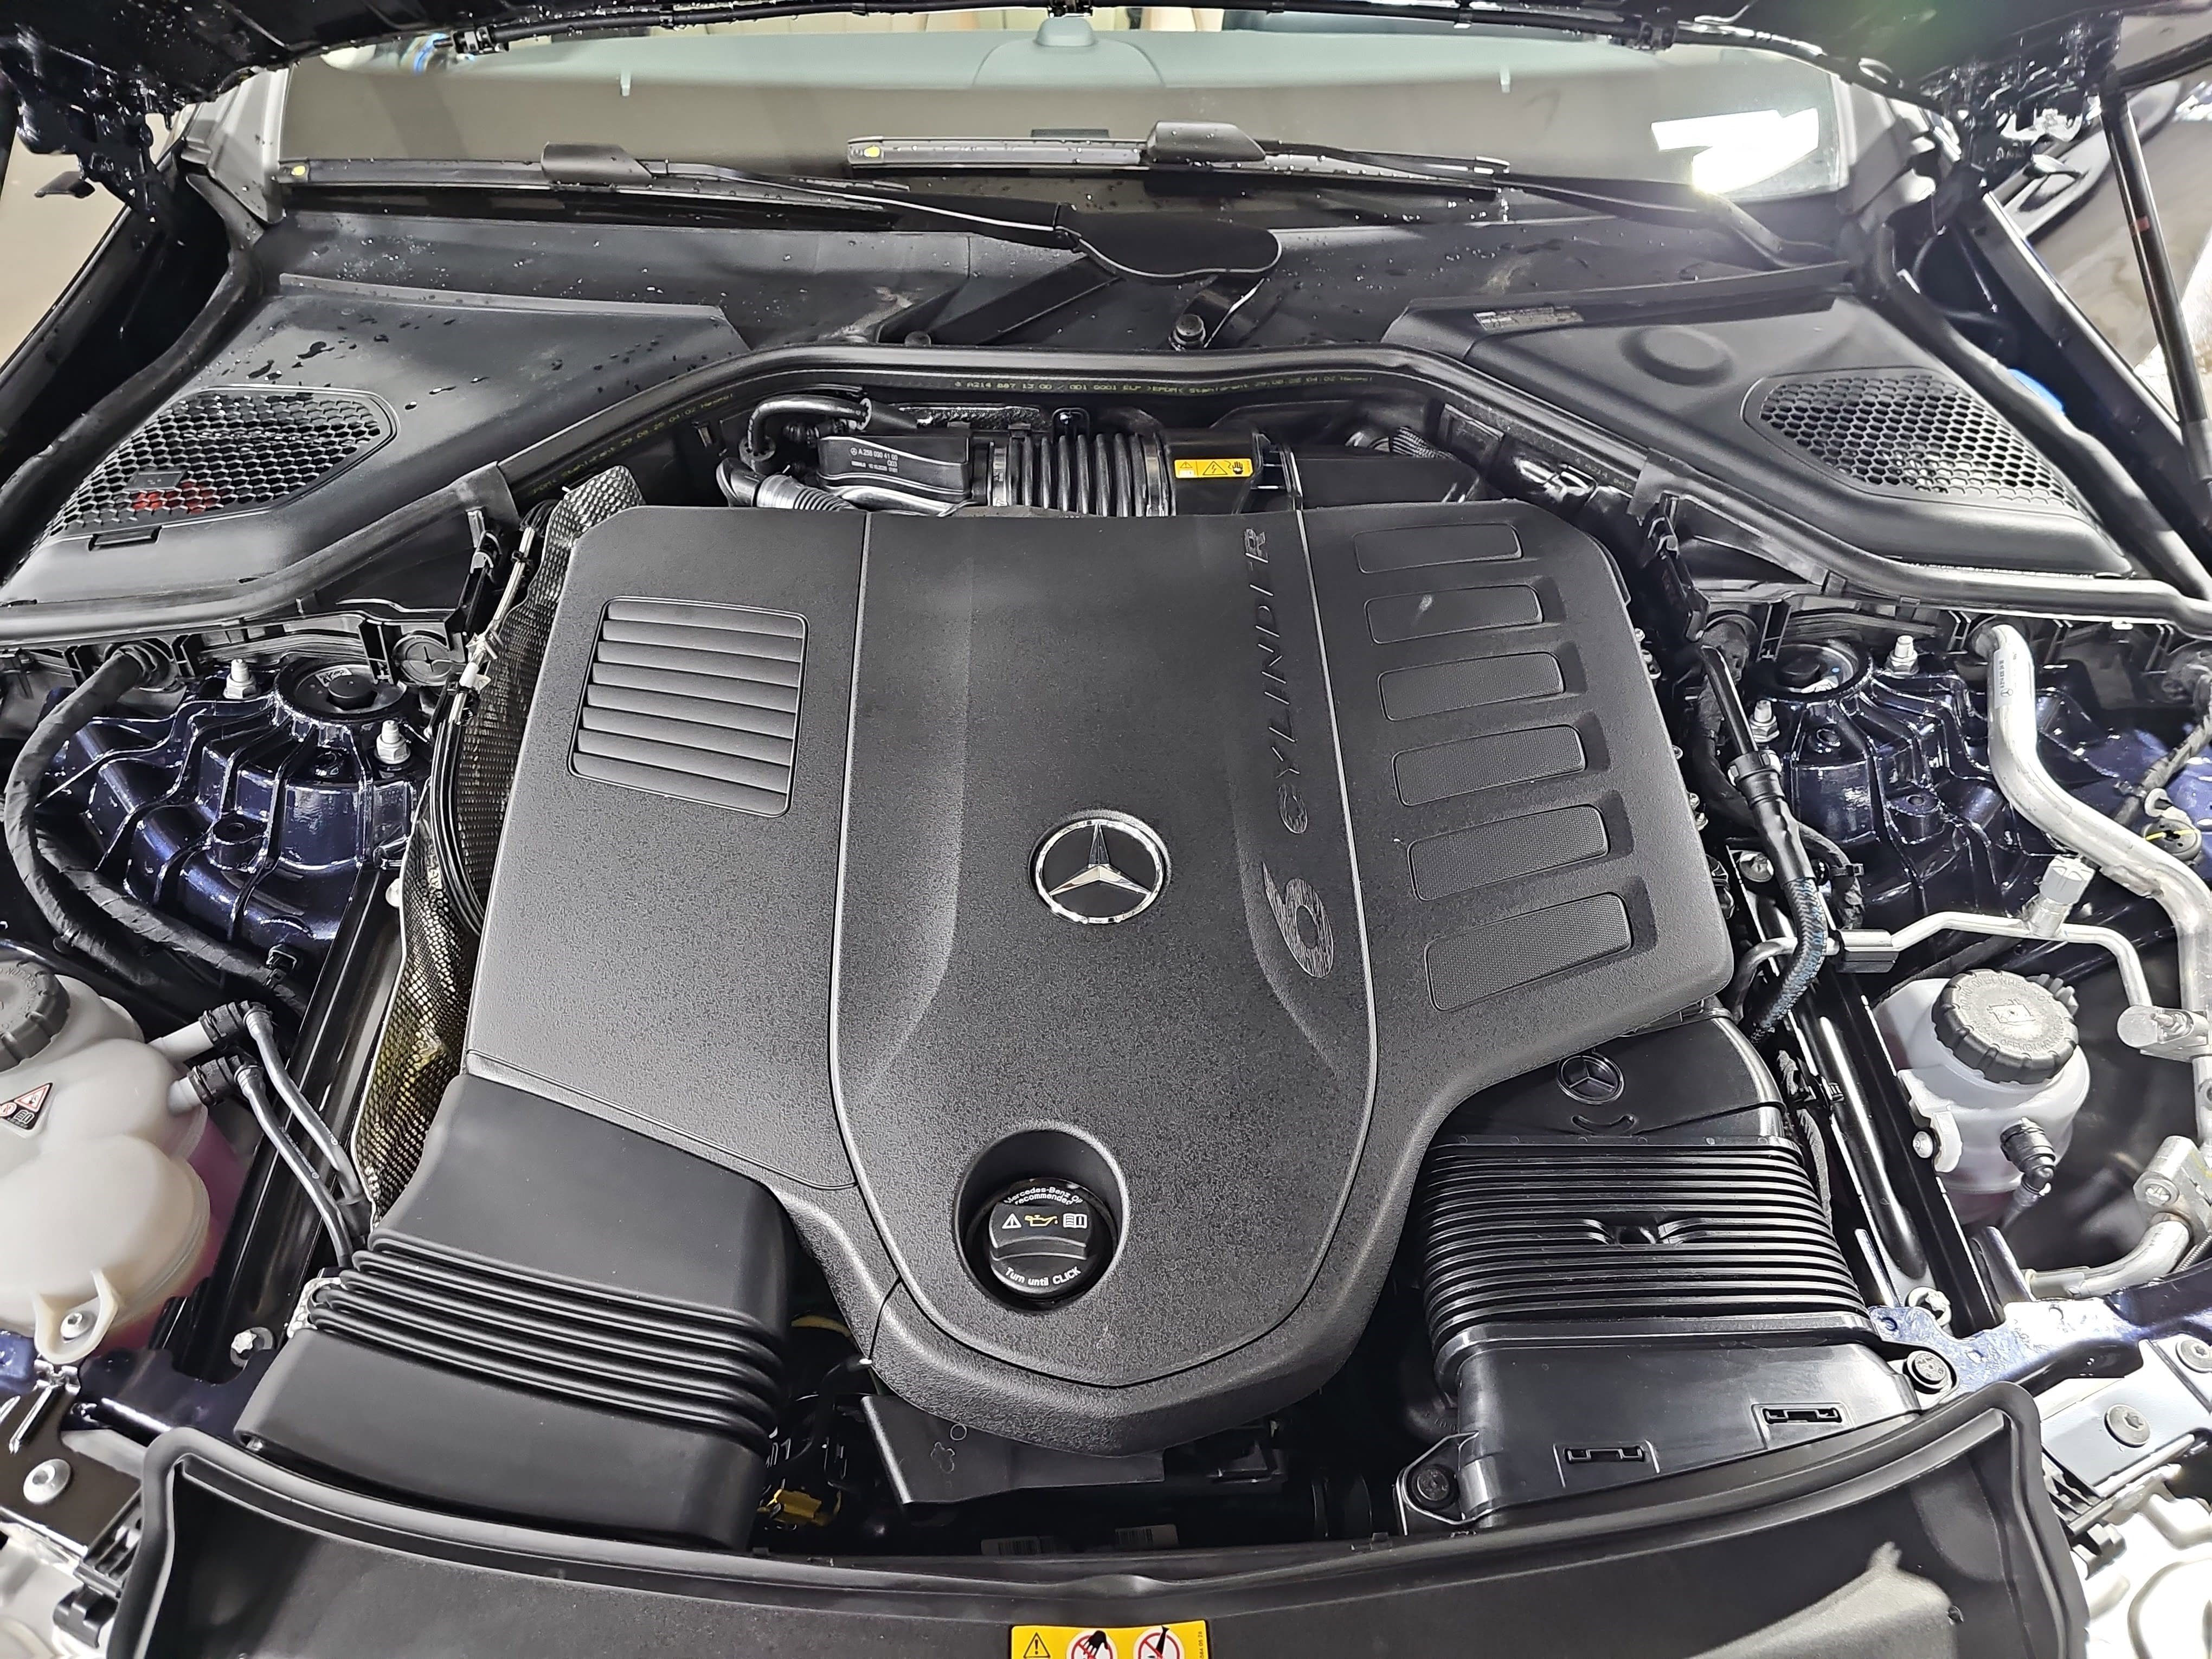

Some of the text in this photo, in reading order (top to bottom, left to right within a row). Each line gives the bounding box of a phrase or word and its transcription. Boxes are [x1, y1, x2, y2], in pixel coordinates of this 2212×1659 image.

[1262, 861, 1334, 978] 6
[1003, 1186, 1071, 1204] Mercedes-Benz
[1014, 1193, 1073, 1205] recommended
[1005, 1266, 1081, 1286] Turn until CLICK
